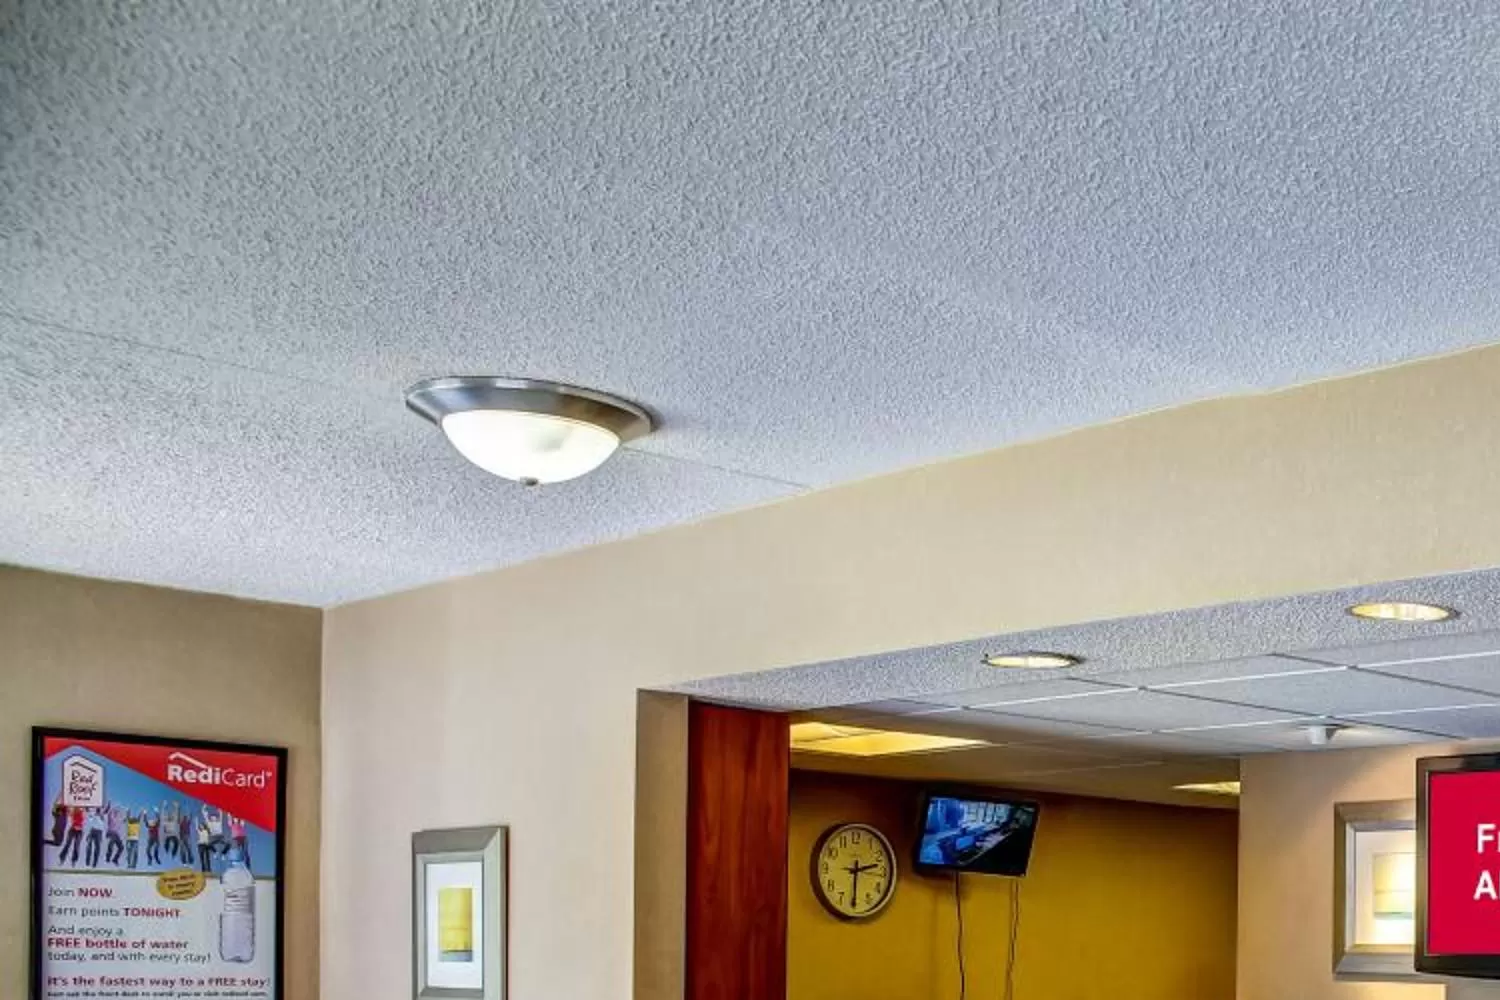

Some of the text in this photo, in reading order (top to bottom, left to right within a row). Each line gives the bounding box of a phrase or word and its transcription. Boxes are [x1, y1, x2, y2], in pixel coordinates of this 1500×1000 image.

[48, 886, 113, 898] Join NOW
[48, 905, 181, 918] Earn points TONIGHT
[48, 924, 124, 938] And enjoy a
[47, 937, 189, 949] FREE bottle of water
[91, 951, 115, 961] and
[117, 952, 146, 961] with
[149, 953, 180, 964] every
[183, 952, 211, 964] stay!
[47, 976, 271, 989] It's the fastest way to a FREE stay!
